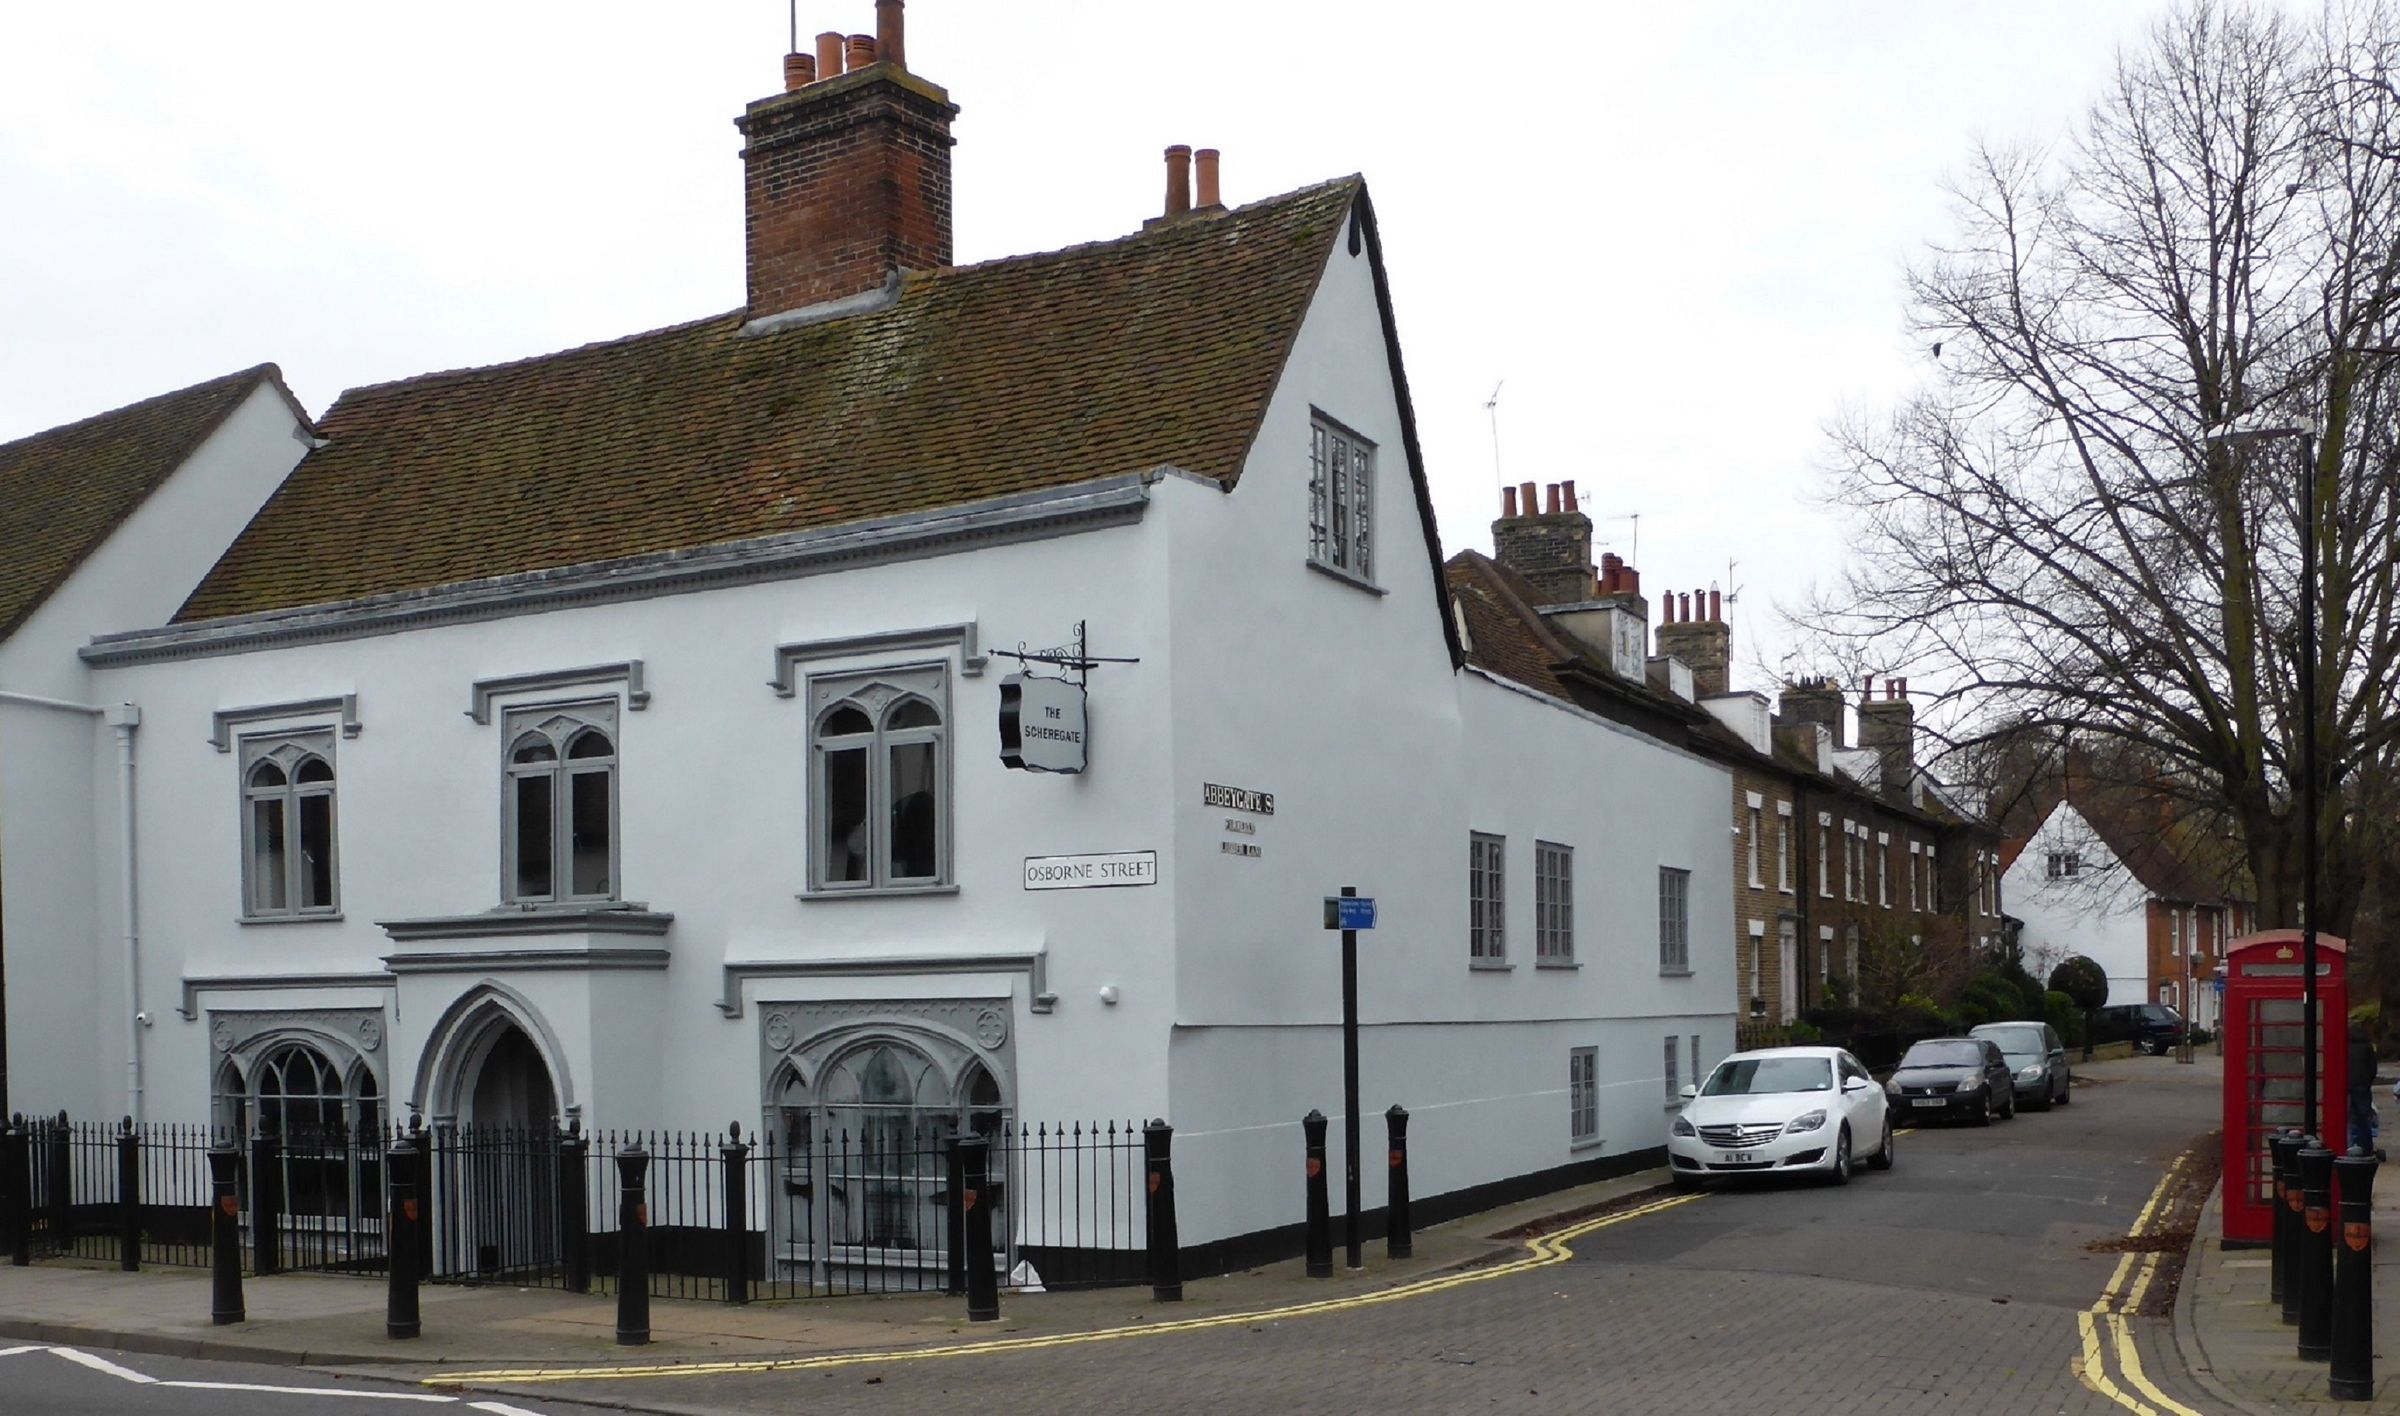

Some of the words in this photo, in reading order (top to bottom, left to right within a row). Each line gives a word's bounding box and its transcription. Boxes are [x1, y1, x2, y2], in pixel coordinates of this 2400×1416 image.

[1045, 706, 1061, 719] THE
[1025, 725, 1081, 744] SCHEREGATE
[1204, 784, 1262, 812] ABBEYGATE
[1027, 863, 1093, 881] OSBORNE
[1101, 861, 1154, 878] STREET
